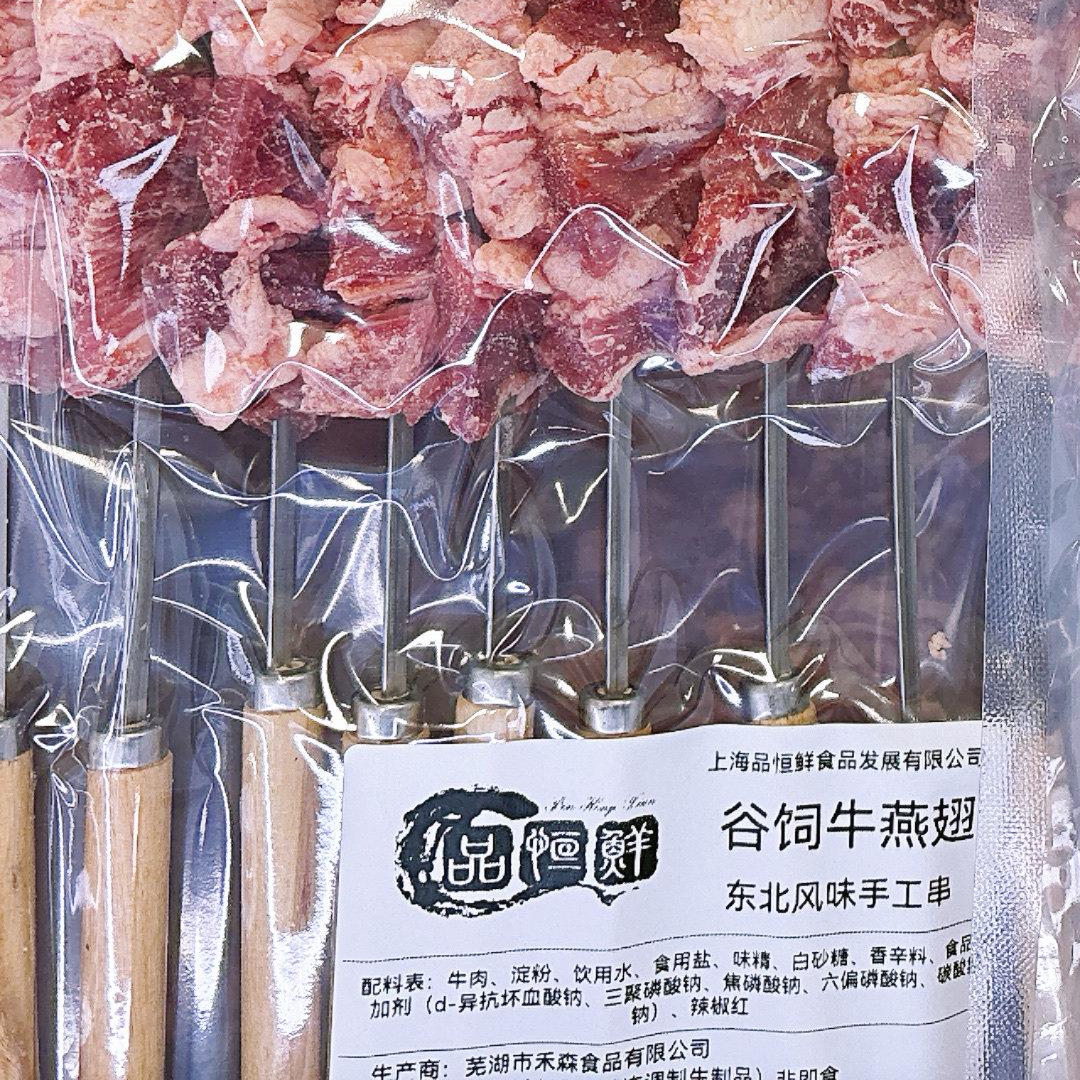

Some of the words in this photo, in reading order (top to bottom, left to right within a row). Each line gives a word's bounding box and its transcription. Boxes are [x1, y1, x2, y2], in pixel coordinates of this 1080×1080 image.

[707, 746, 982, 774] 上海品恒鲜食品发展有限公司
[720, 796, 977, 852] 谷饲牛燕翅
[725, 875, 951, 914] 东北风味手工串
